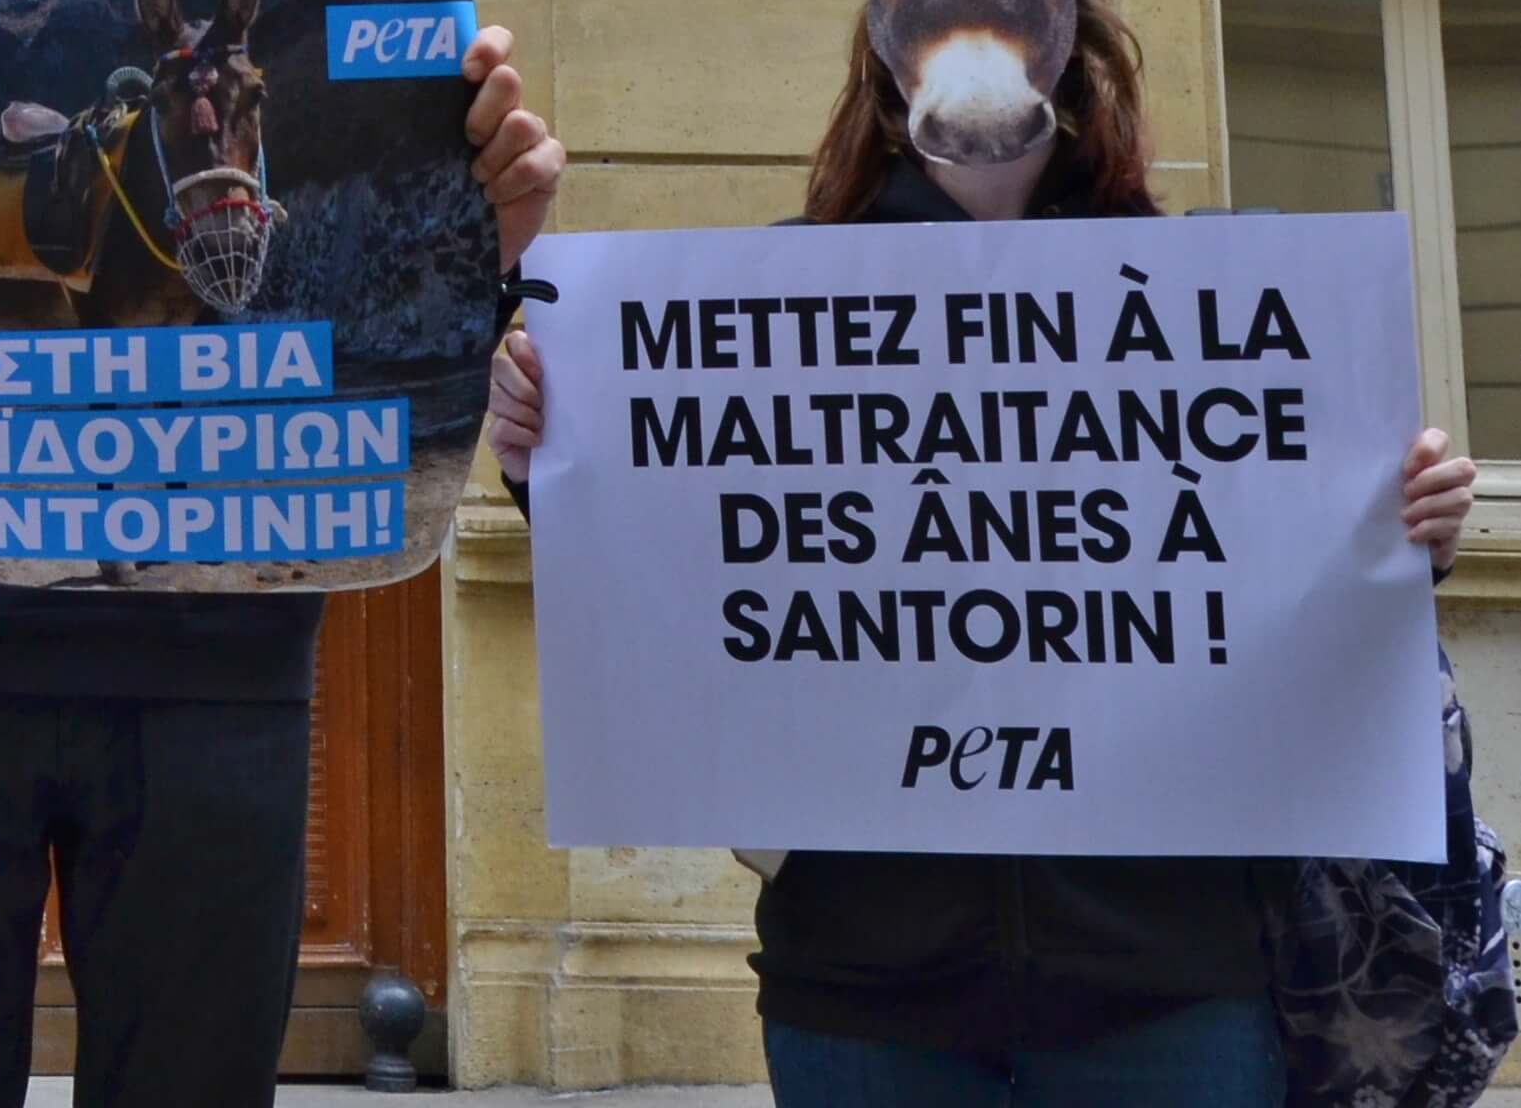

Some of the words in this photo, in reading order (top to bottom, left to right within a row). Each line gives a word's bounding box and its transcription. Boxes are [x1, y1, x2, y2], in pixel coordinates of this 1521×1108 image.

[620, 292, 919, 372] METTEZ
[946, 291, 1079, 365] FIN
[1106, 262, 1174, 362] À
[1199, 287, 1311, 362] LA
[180, 330, 322, 391] ΒΙΑ
[629, 386, 1309, 469] MALTRAITANCE
[719, 490, 878, 564] DES
[902, 467, 1131, 564] ÂNES
[1157, 461, 1228, 563] À
[721, 589, 1176, 665] SANTORIN
[1206, 591, 1229, 665] !
